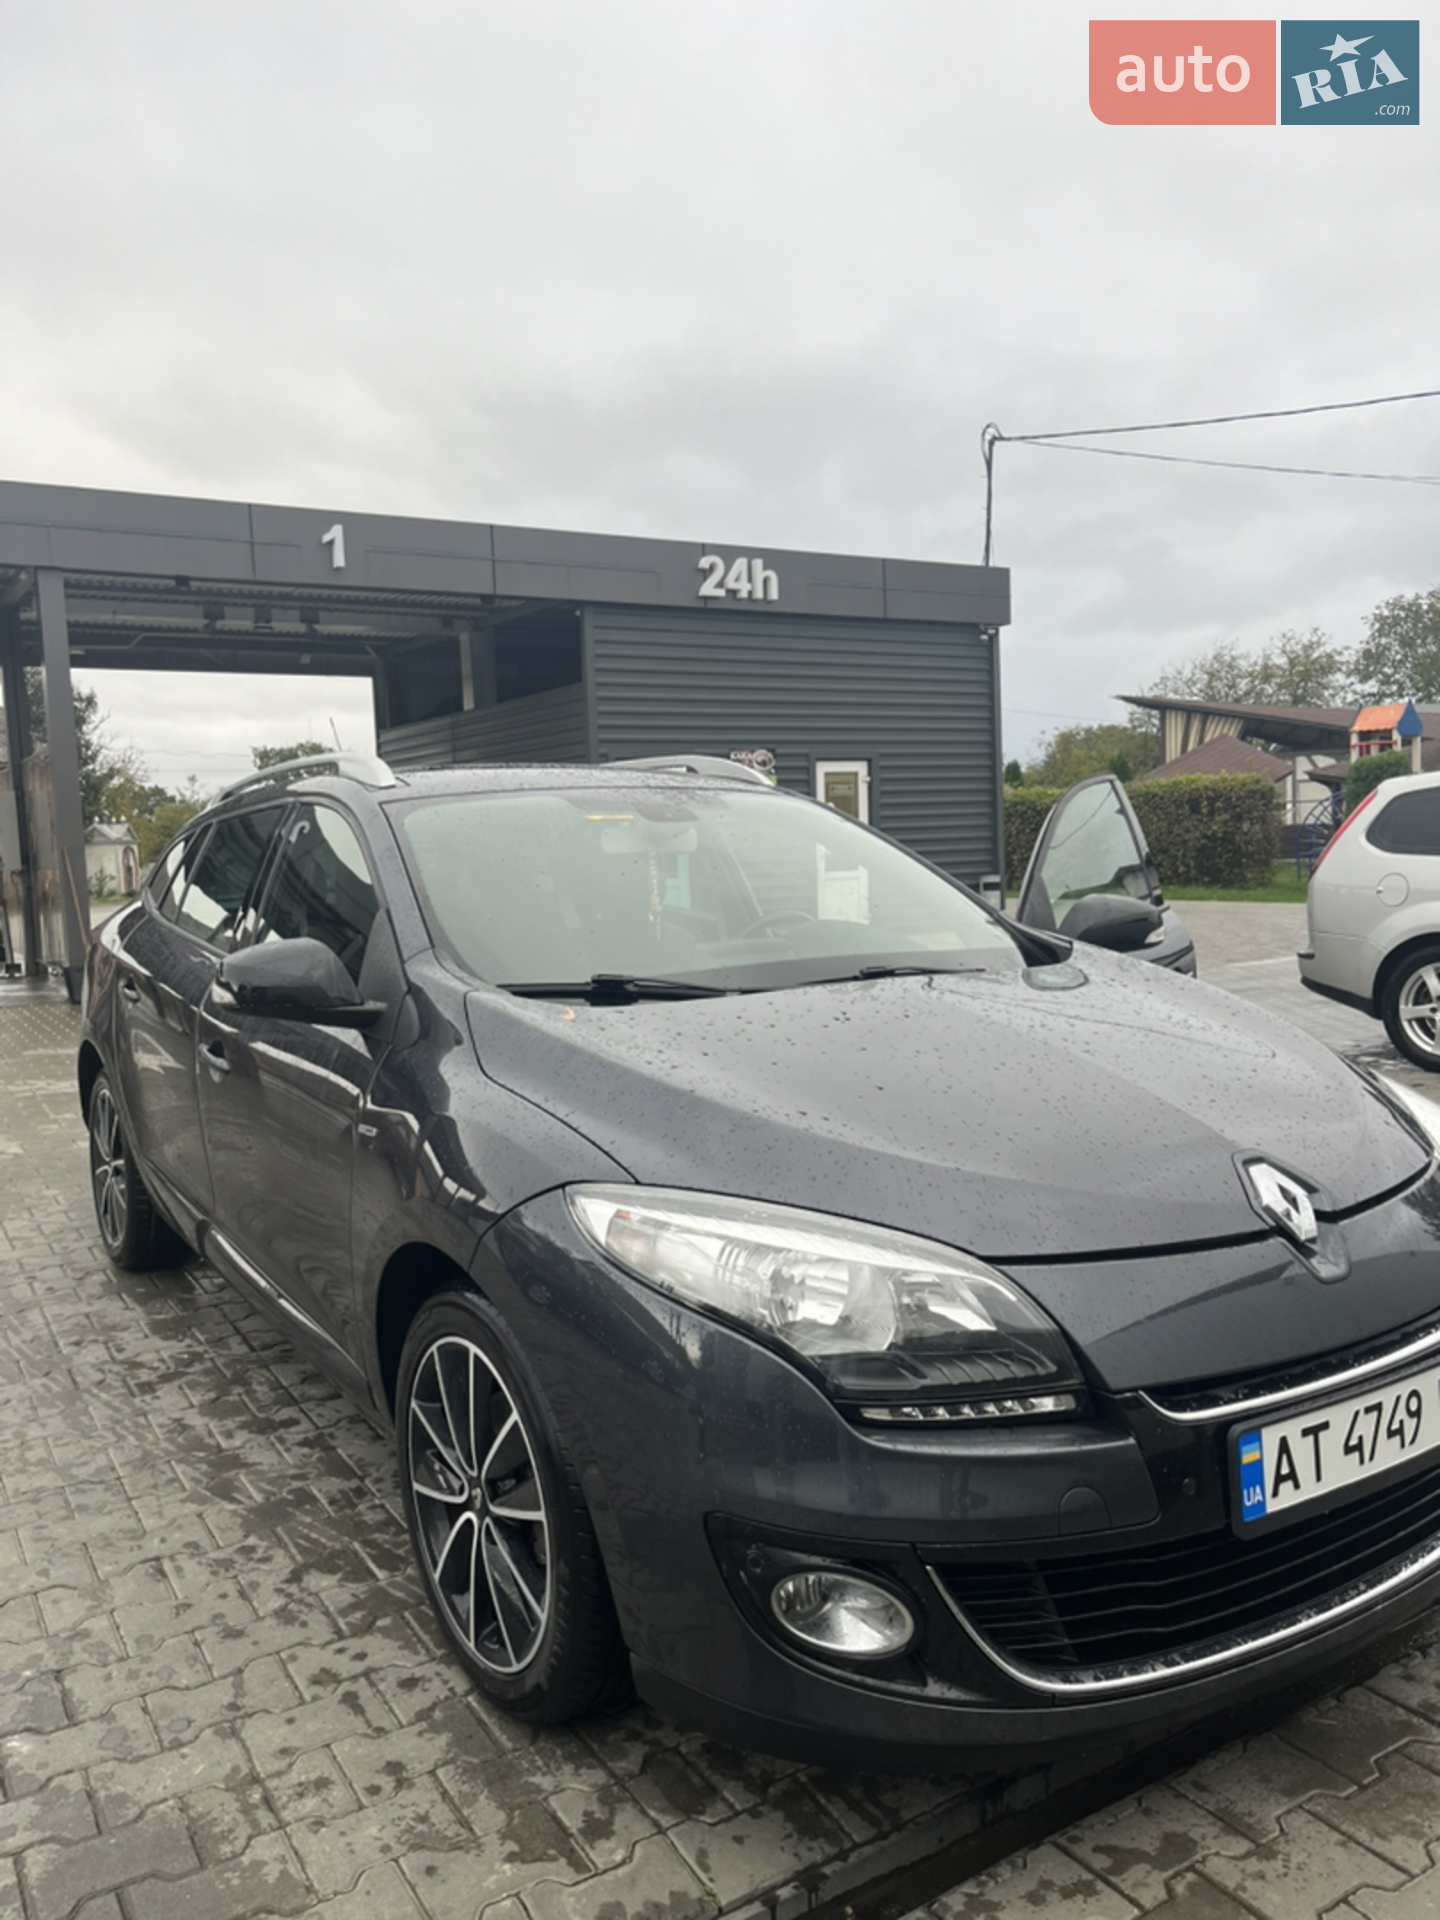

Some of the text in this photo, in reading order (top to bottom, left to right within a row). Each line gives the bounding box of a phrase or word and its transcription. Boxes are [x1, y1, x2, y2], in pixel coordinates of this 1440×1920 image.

[321, 524, 346, 569] 1
[698, 555, 779, 601] 24h
[1271, 1389, 1422, 1499] AT 4749
[1243, 1485, 1264, 1507] UA
